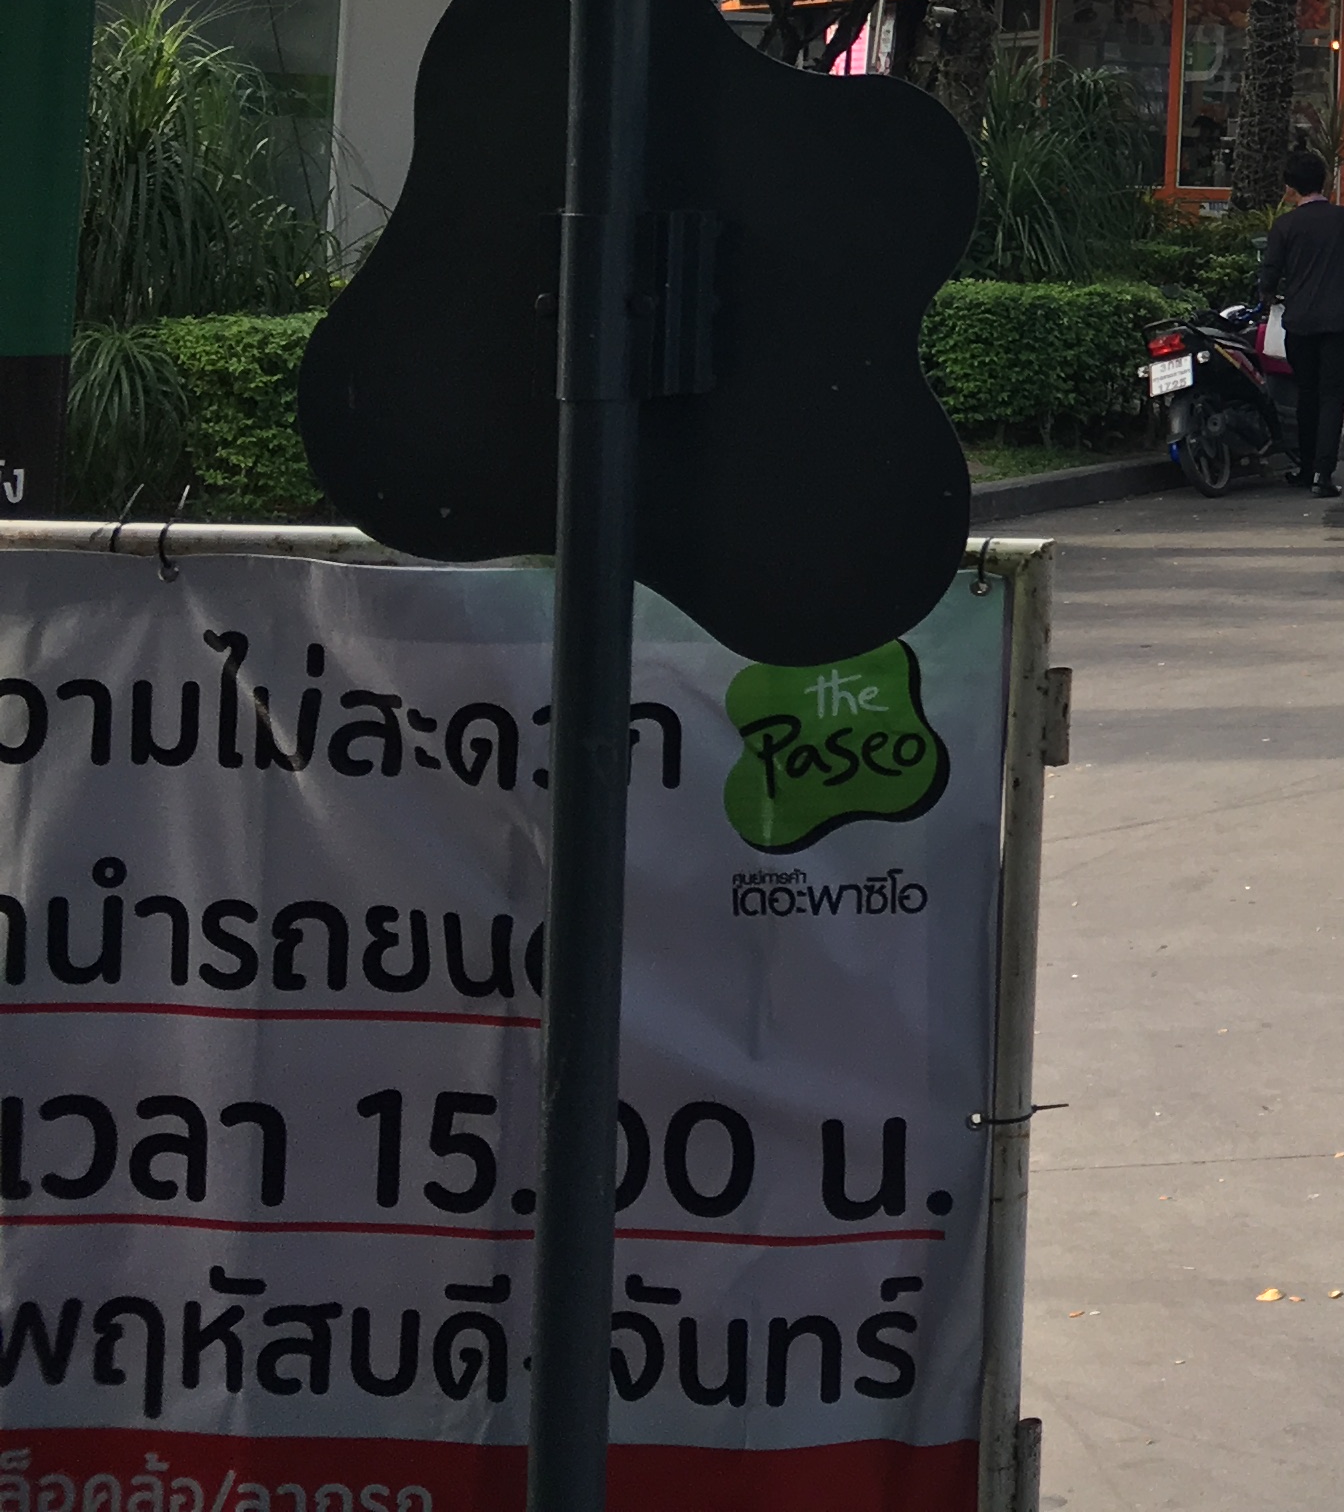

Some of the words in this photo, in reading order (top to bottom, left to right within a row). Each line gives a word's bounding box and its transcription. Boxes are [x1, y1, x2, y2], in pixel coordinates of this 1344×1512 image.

[803, 668, 890, 719] the
[739, 713, 927, 800] Paseo
[732, 869, 928, 917] เดอะพาซิโอ
[0, 1093, 288, 1208] เวลา
[820, 1116, 955, 1221] น.
